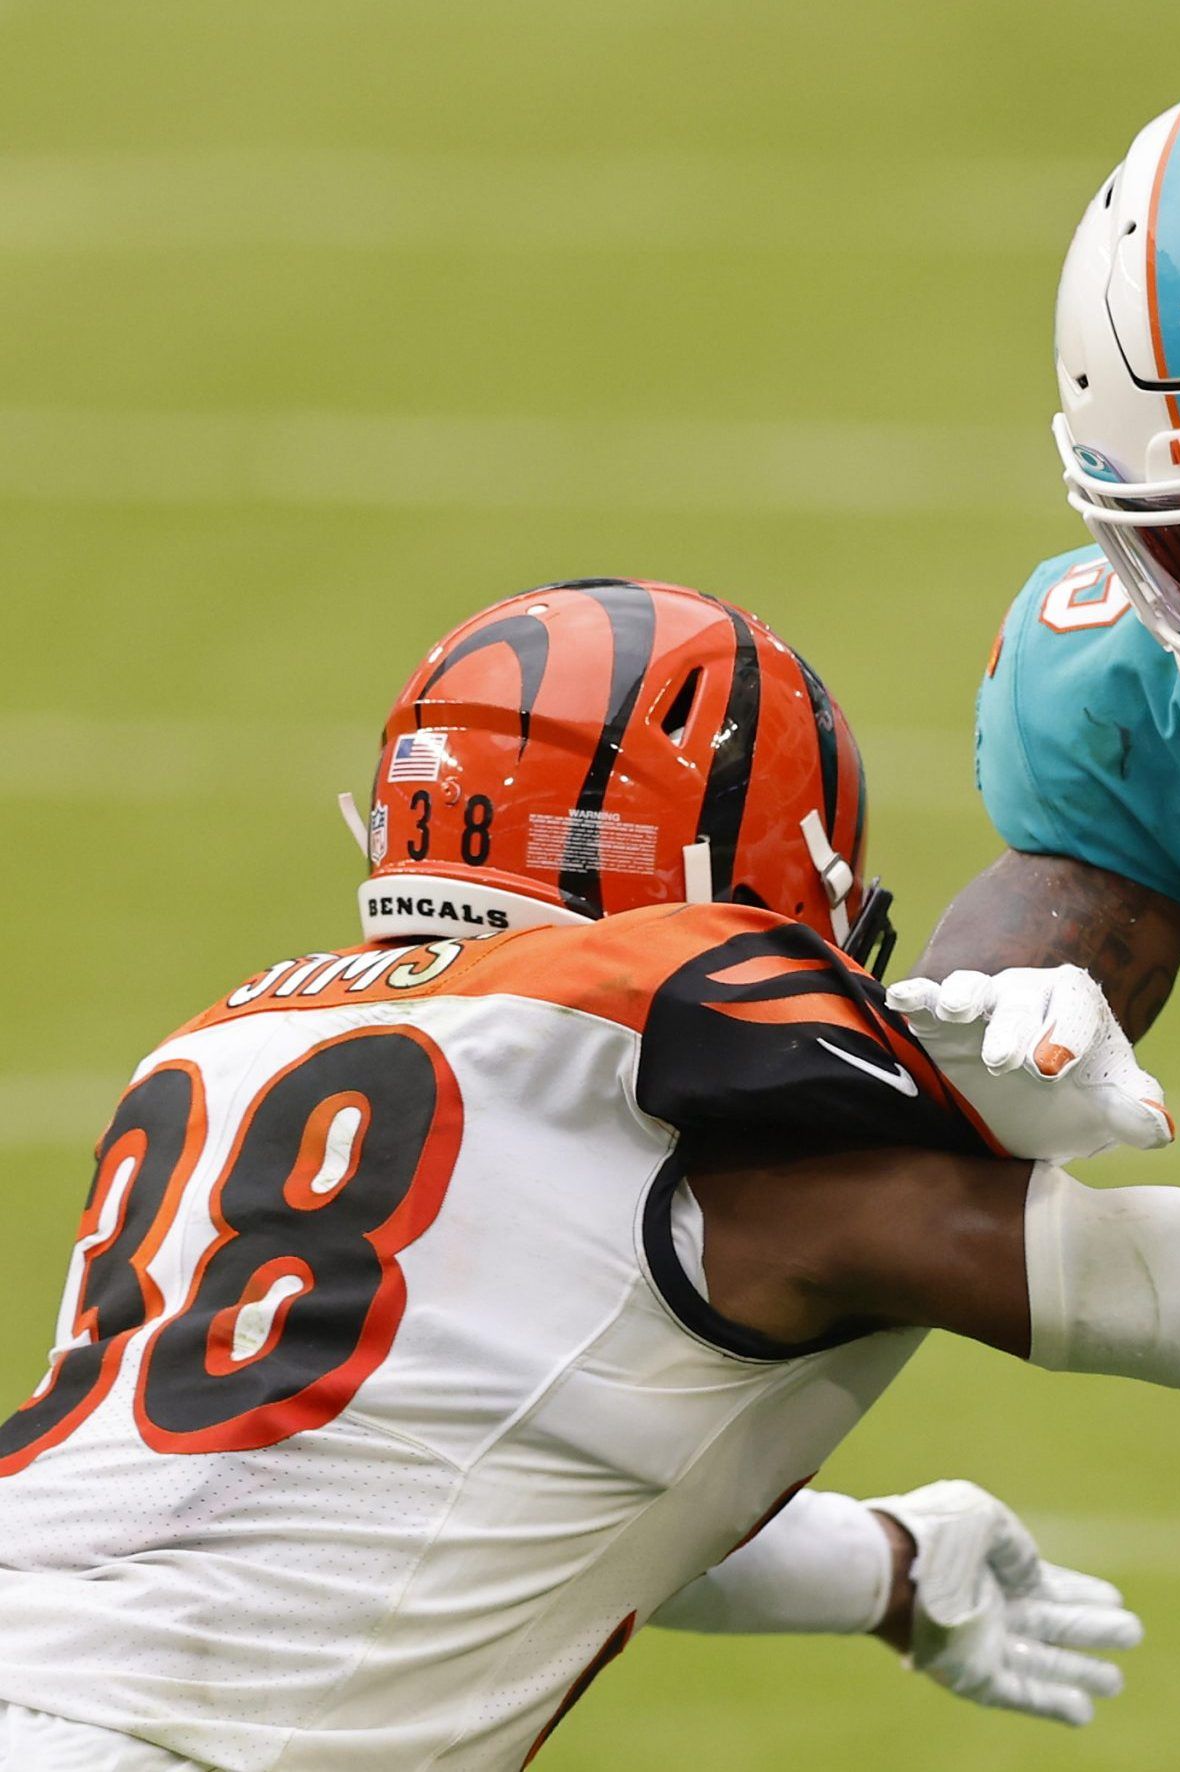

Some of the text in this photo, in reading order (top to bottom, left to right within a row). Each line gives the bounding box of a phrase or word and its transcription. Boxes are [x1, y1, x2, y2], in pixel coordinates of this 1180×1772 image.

[568, 808, 621, 823] WARNING
[368, 897, 509, 929] BENGALS
[0, 1023, 465, 1478] 38
